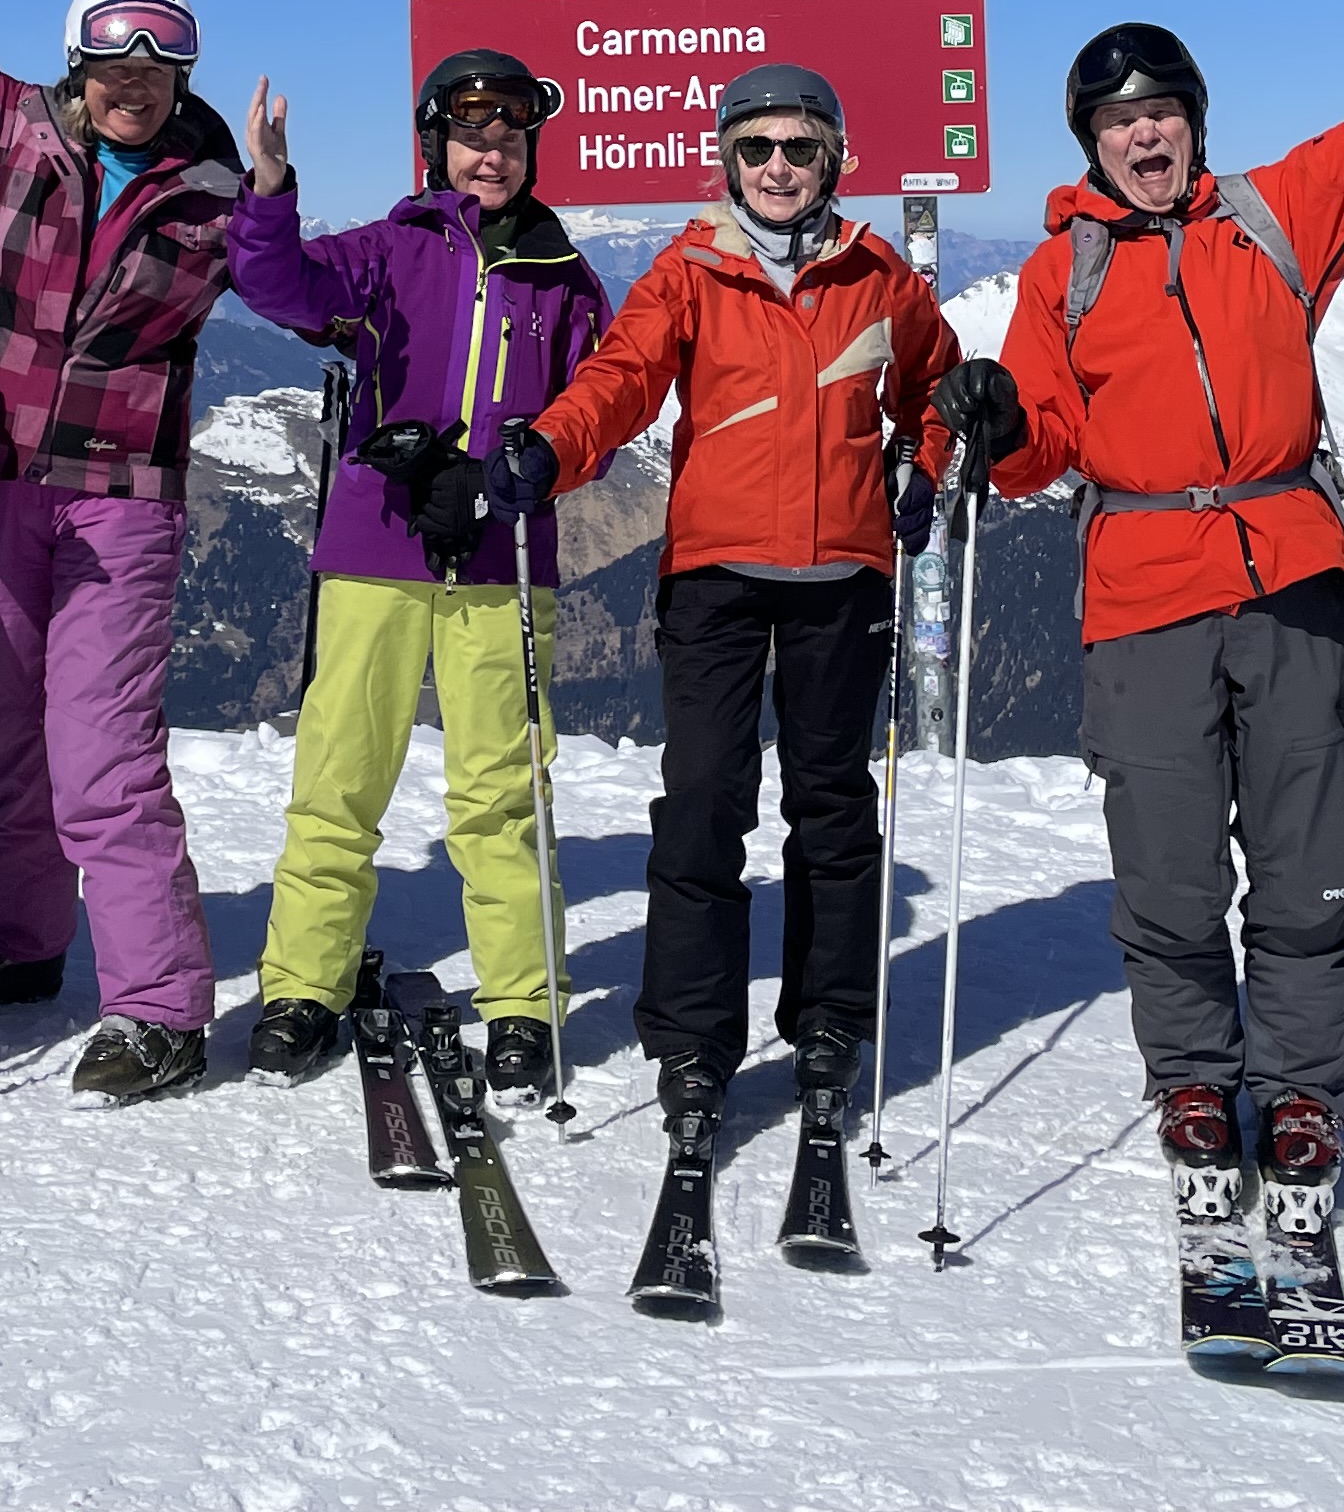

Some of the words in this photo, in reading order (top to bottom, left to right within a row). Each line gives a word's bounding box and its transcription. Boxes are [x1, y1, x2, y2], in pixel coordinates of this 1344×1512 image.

[575, 20, 766, 57] Carmenna
[578, 75, 724, 113] Inner-Ar
[382, 1101, 417, 1166] FISCHE
[808, 1177, 832, 1237] FISCHE
[662, 1213, 695, 1287] FISCHE
